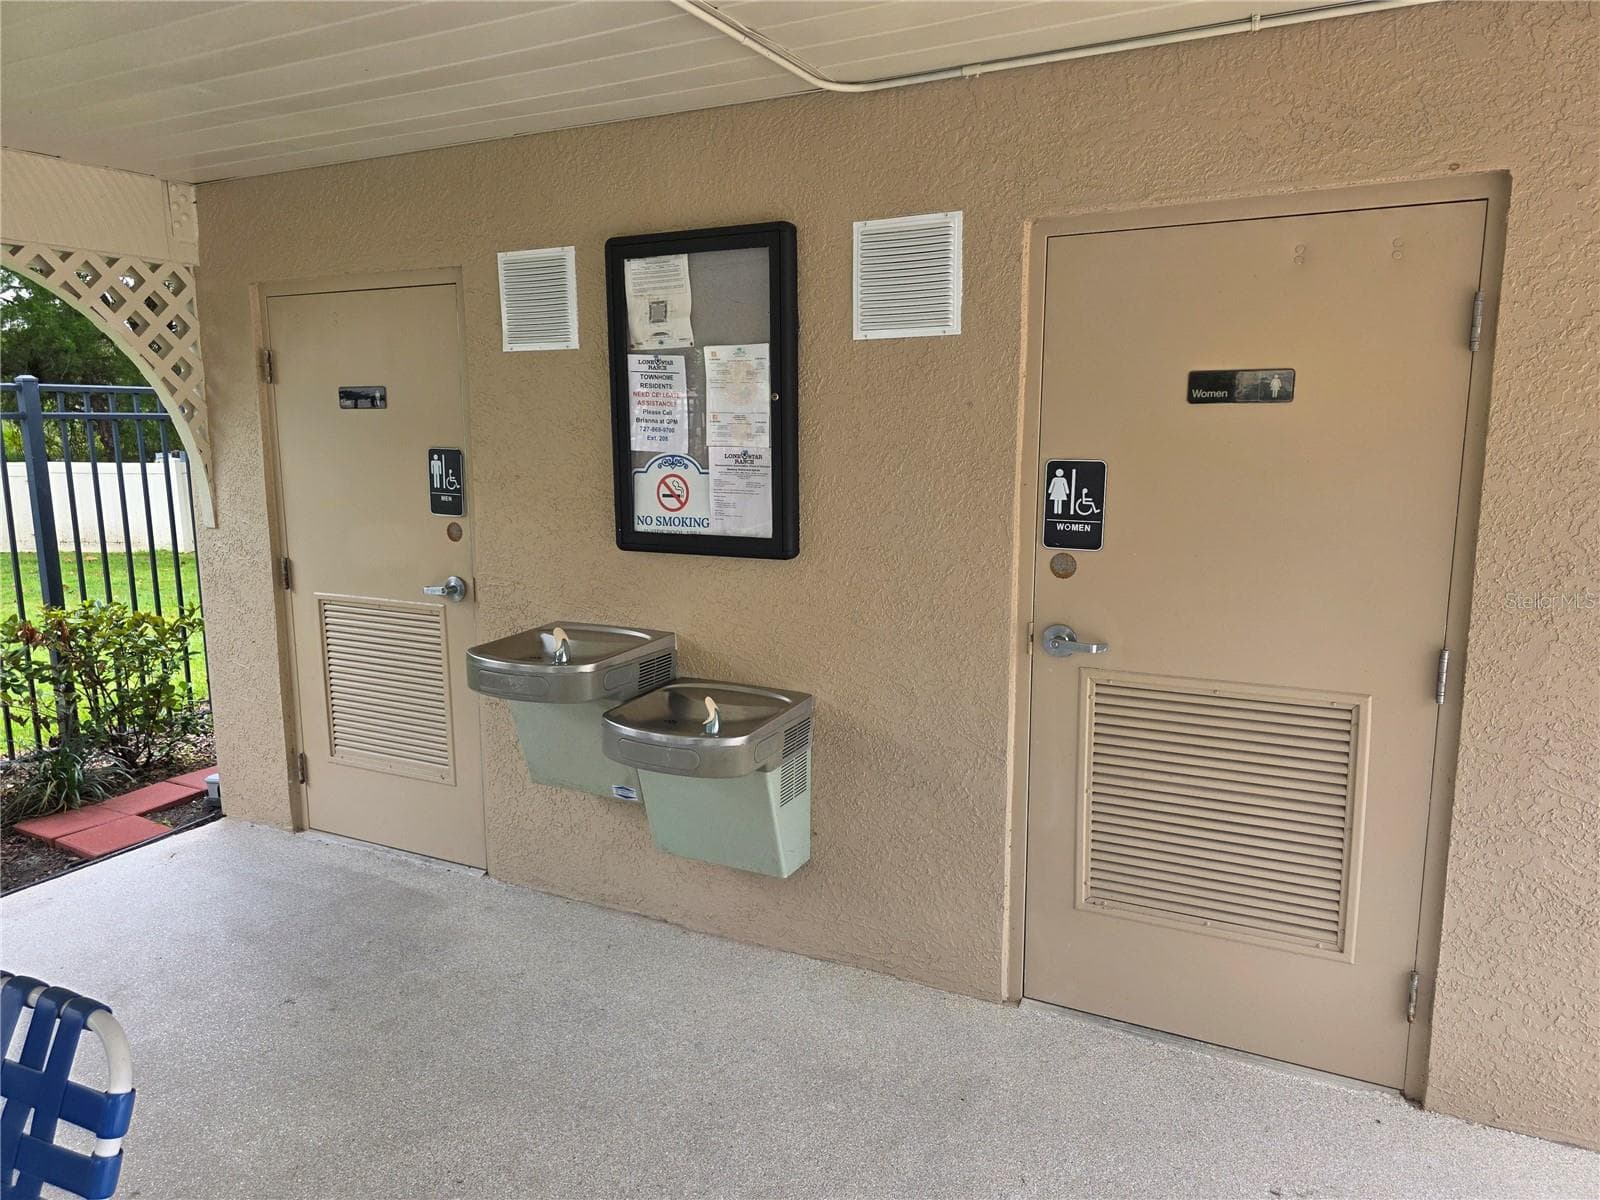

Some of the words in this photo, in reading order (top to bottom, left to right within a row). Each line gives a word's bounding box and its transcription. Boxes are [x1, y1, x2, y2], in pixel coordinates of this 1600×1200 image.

[1192, 389, 1228, 398] Women
[637, 515, 653, 526] NO
[656, 516, 710, 528] SMOKING
[1056, 522, 1091, 532] WOMEN
